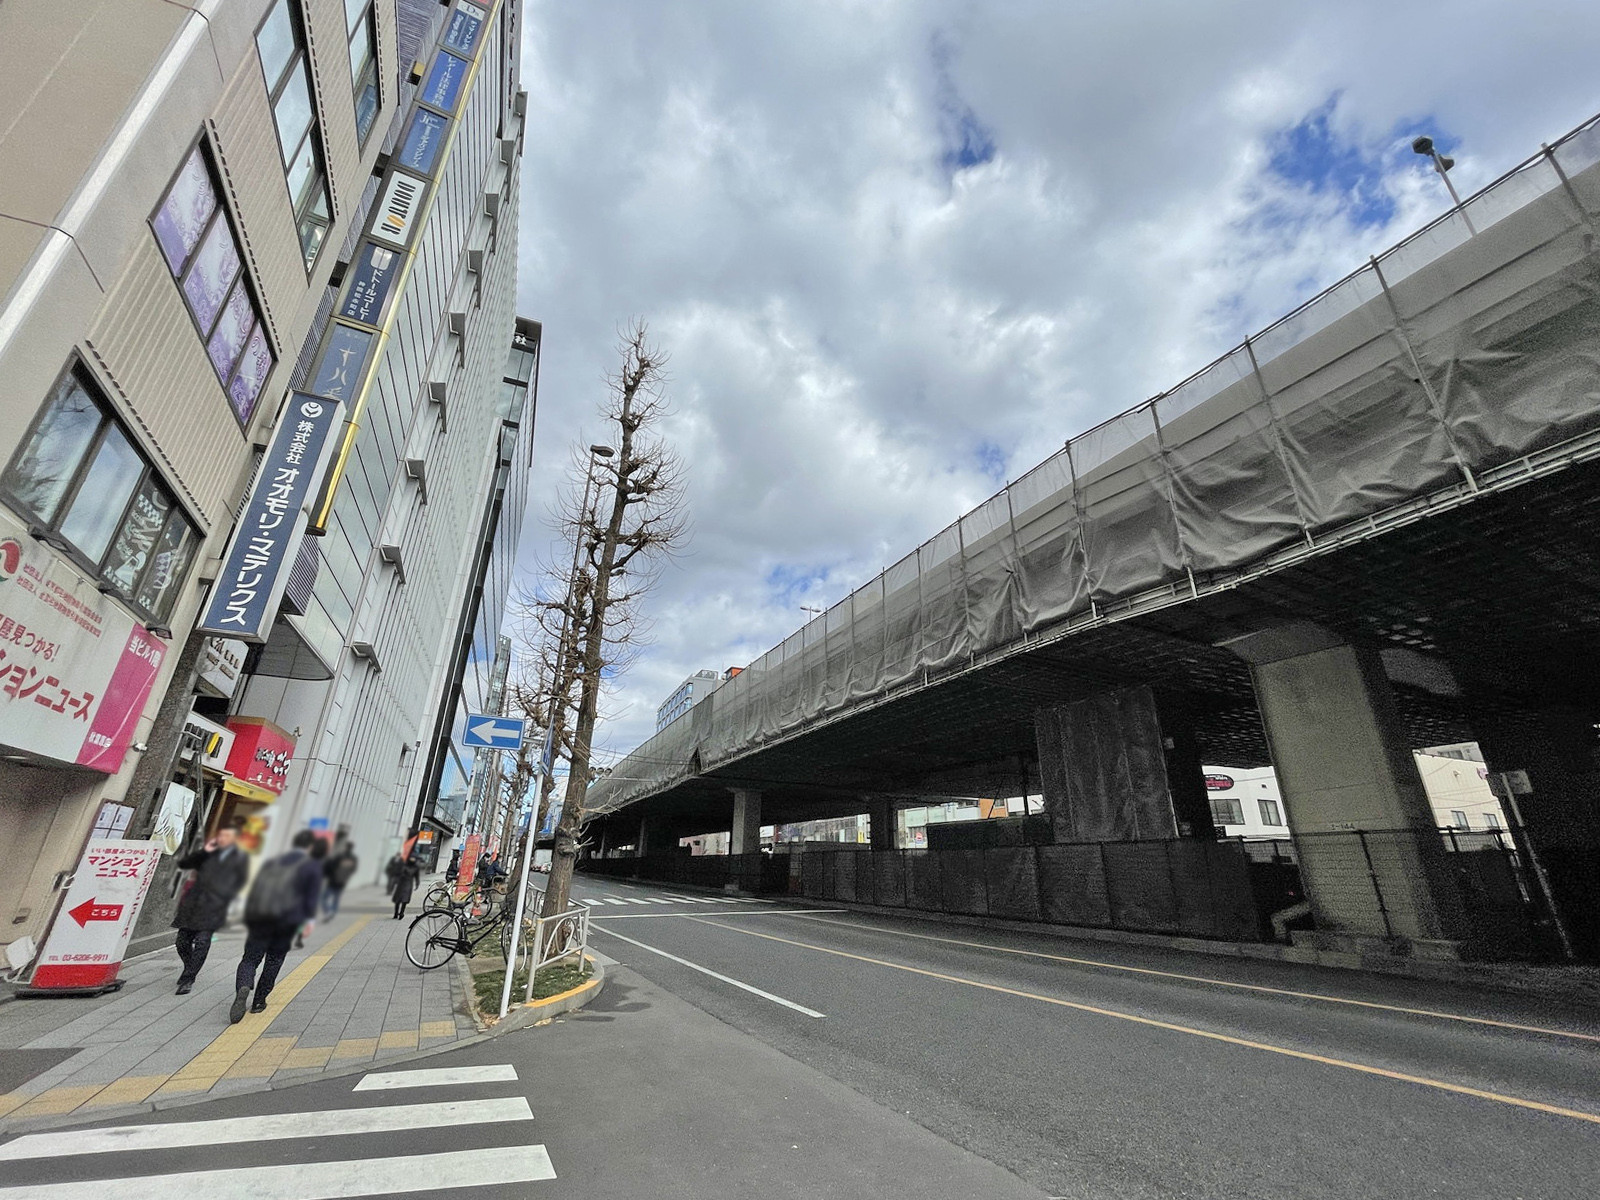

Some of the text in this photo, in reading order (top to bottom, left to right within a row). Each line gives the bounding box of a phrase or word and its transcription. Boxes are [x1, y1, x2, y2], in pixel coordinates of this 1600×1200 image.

[286, 420, 314, 465] 株式会社
[0, 613, 61, 662] 屋見つかる!
[88, 856, 145, 867] マンション
[95, 868, 138, 878] ニュース
[91, 908, 118, 917] こちら
